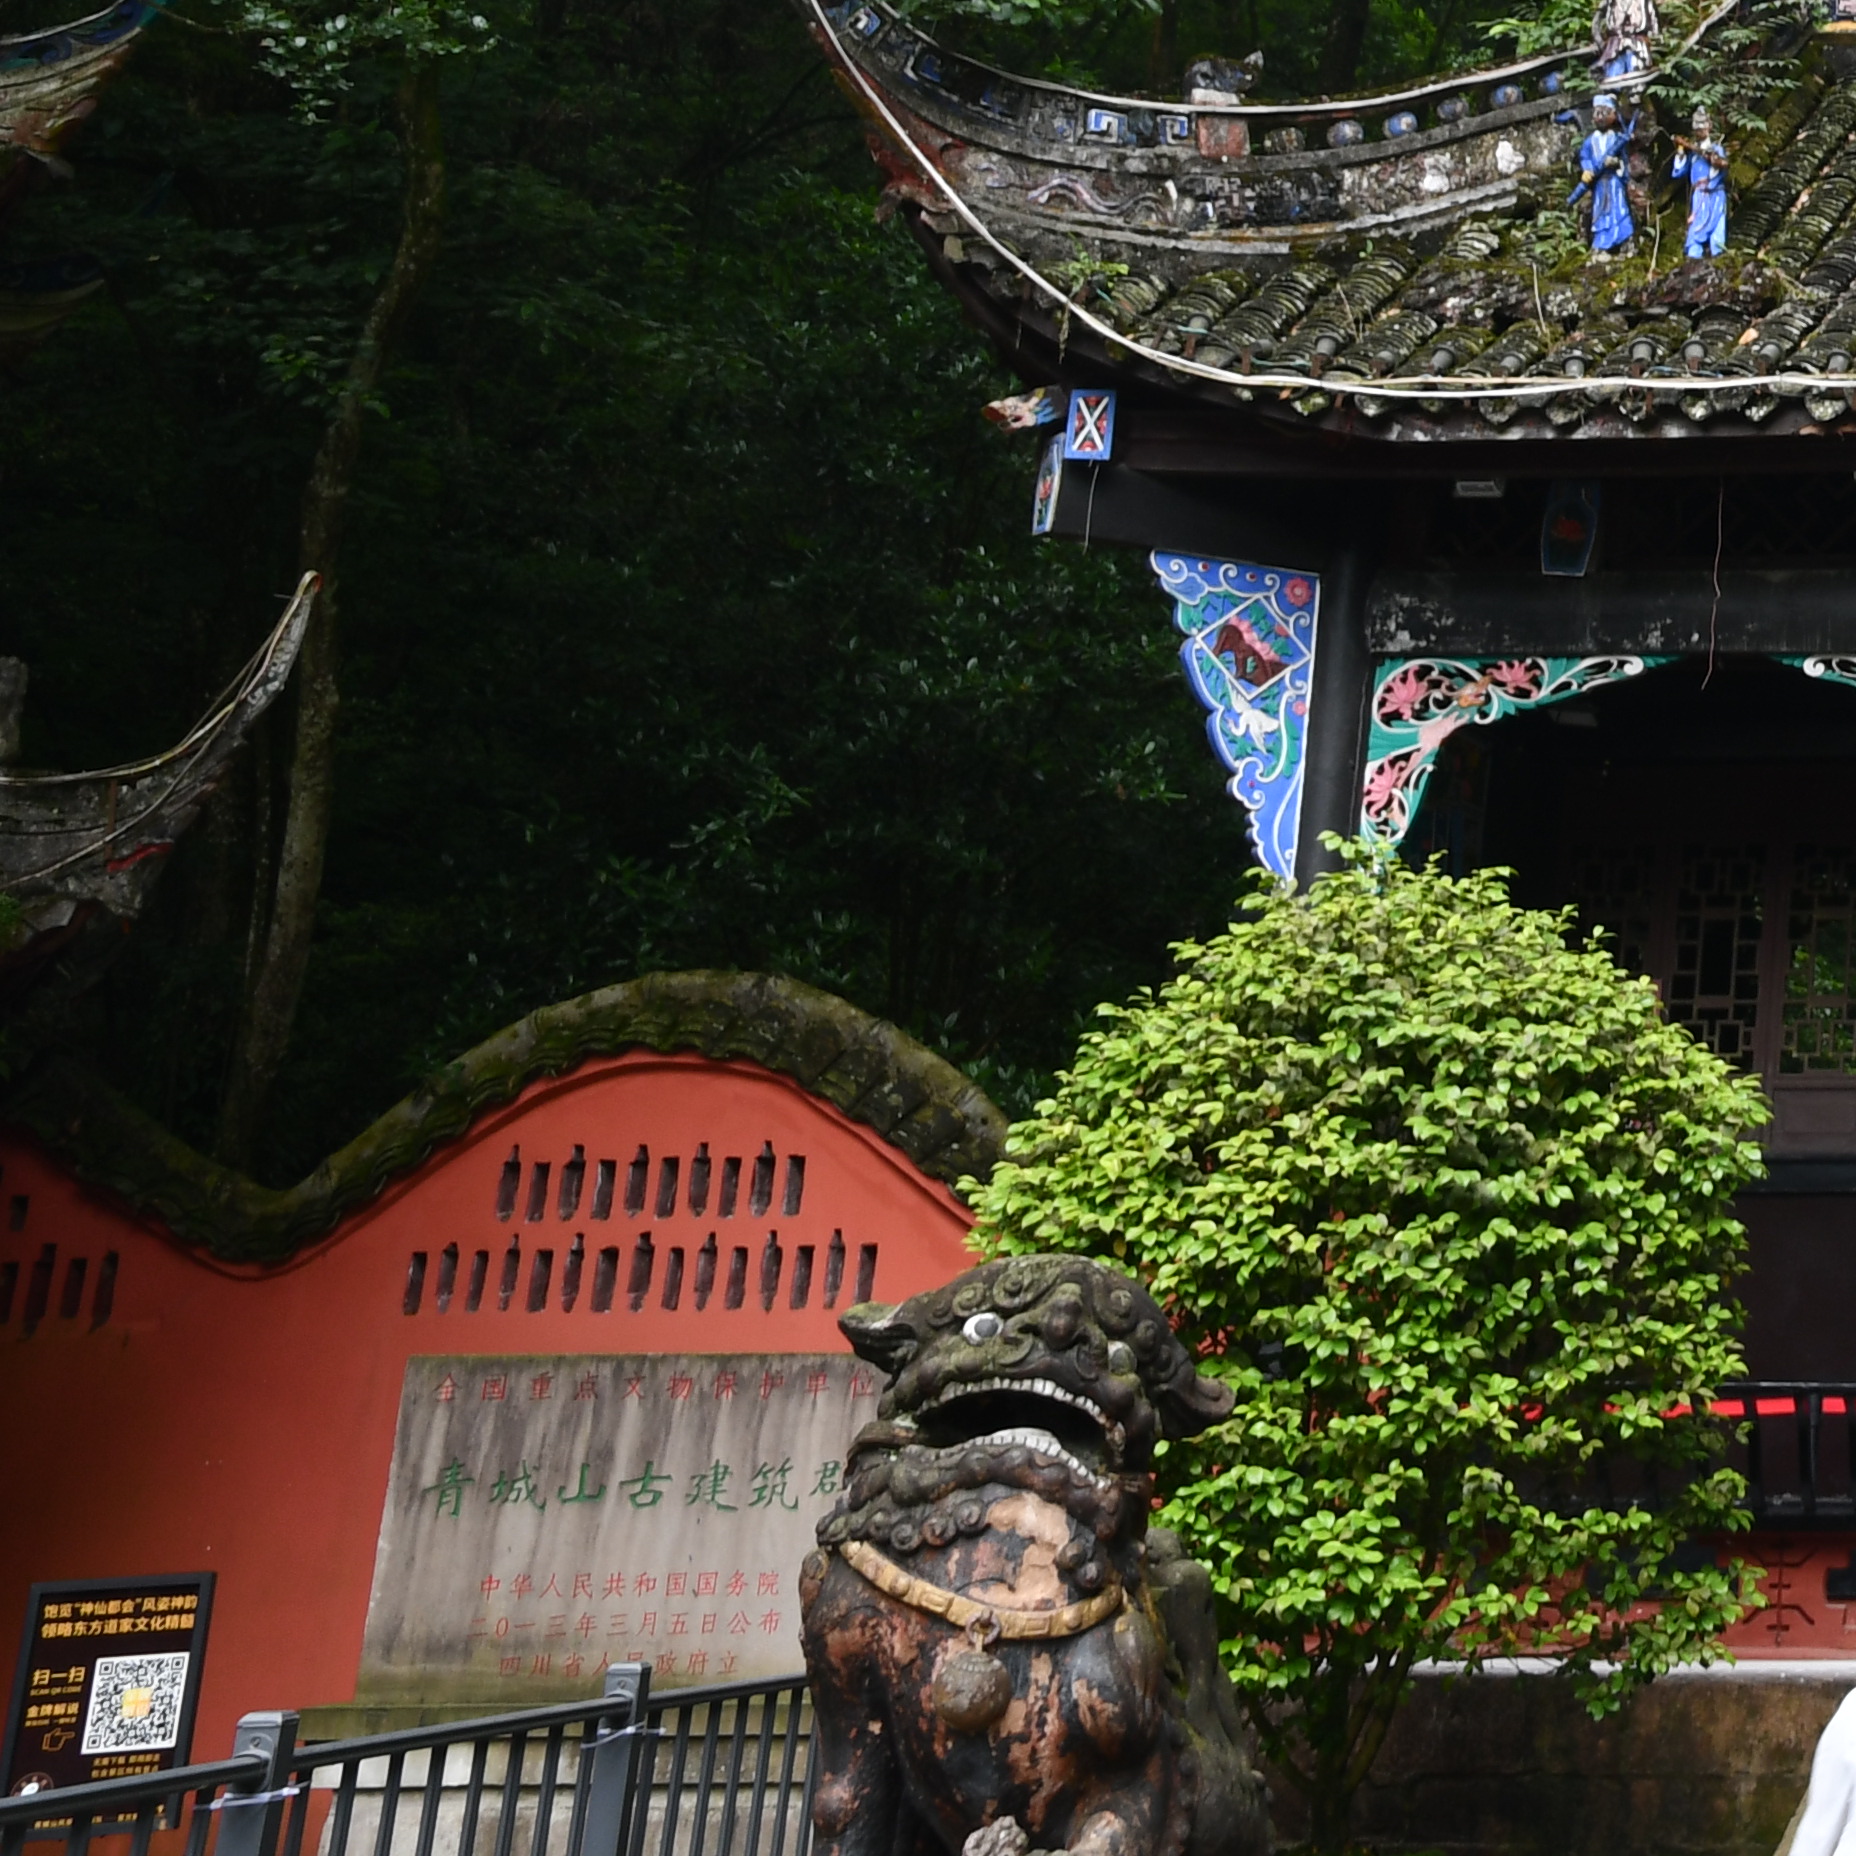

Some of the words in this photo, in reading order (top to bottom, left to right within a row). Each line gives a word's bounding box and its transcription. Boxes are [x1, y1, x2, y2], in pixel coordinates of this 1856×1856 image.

[434, 1370, 877, 1402] 全国重点文物保护单位
[480, 1569, 780, 1600] 中华人民共和国国务院
[41, 1613, 195, 1638] 领略东方道家文化精髓
[33, 1667, 86, 1685] 扫一扫
